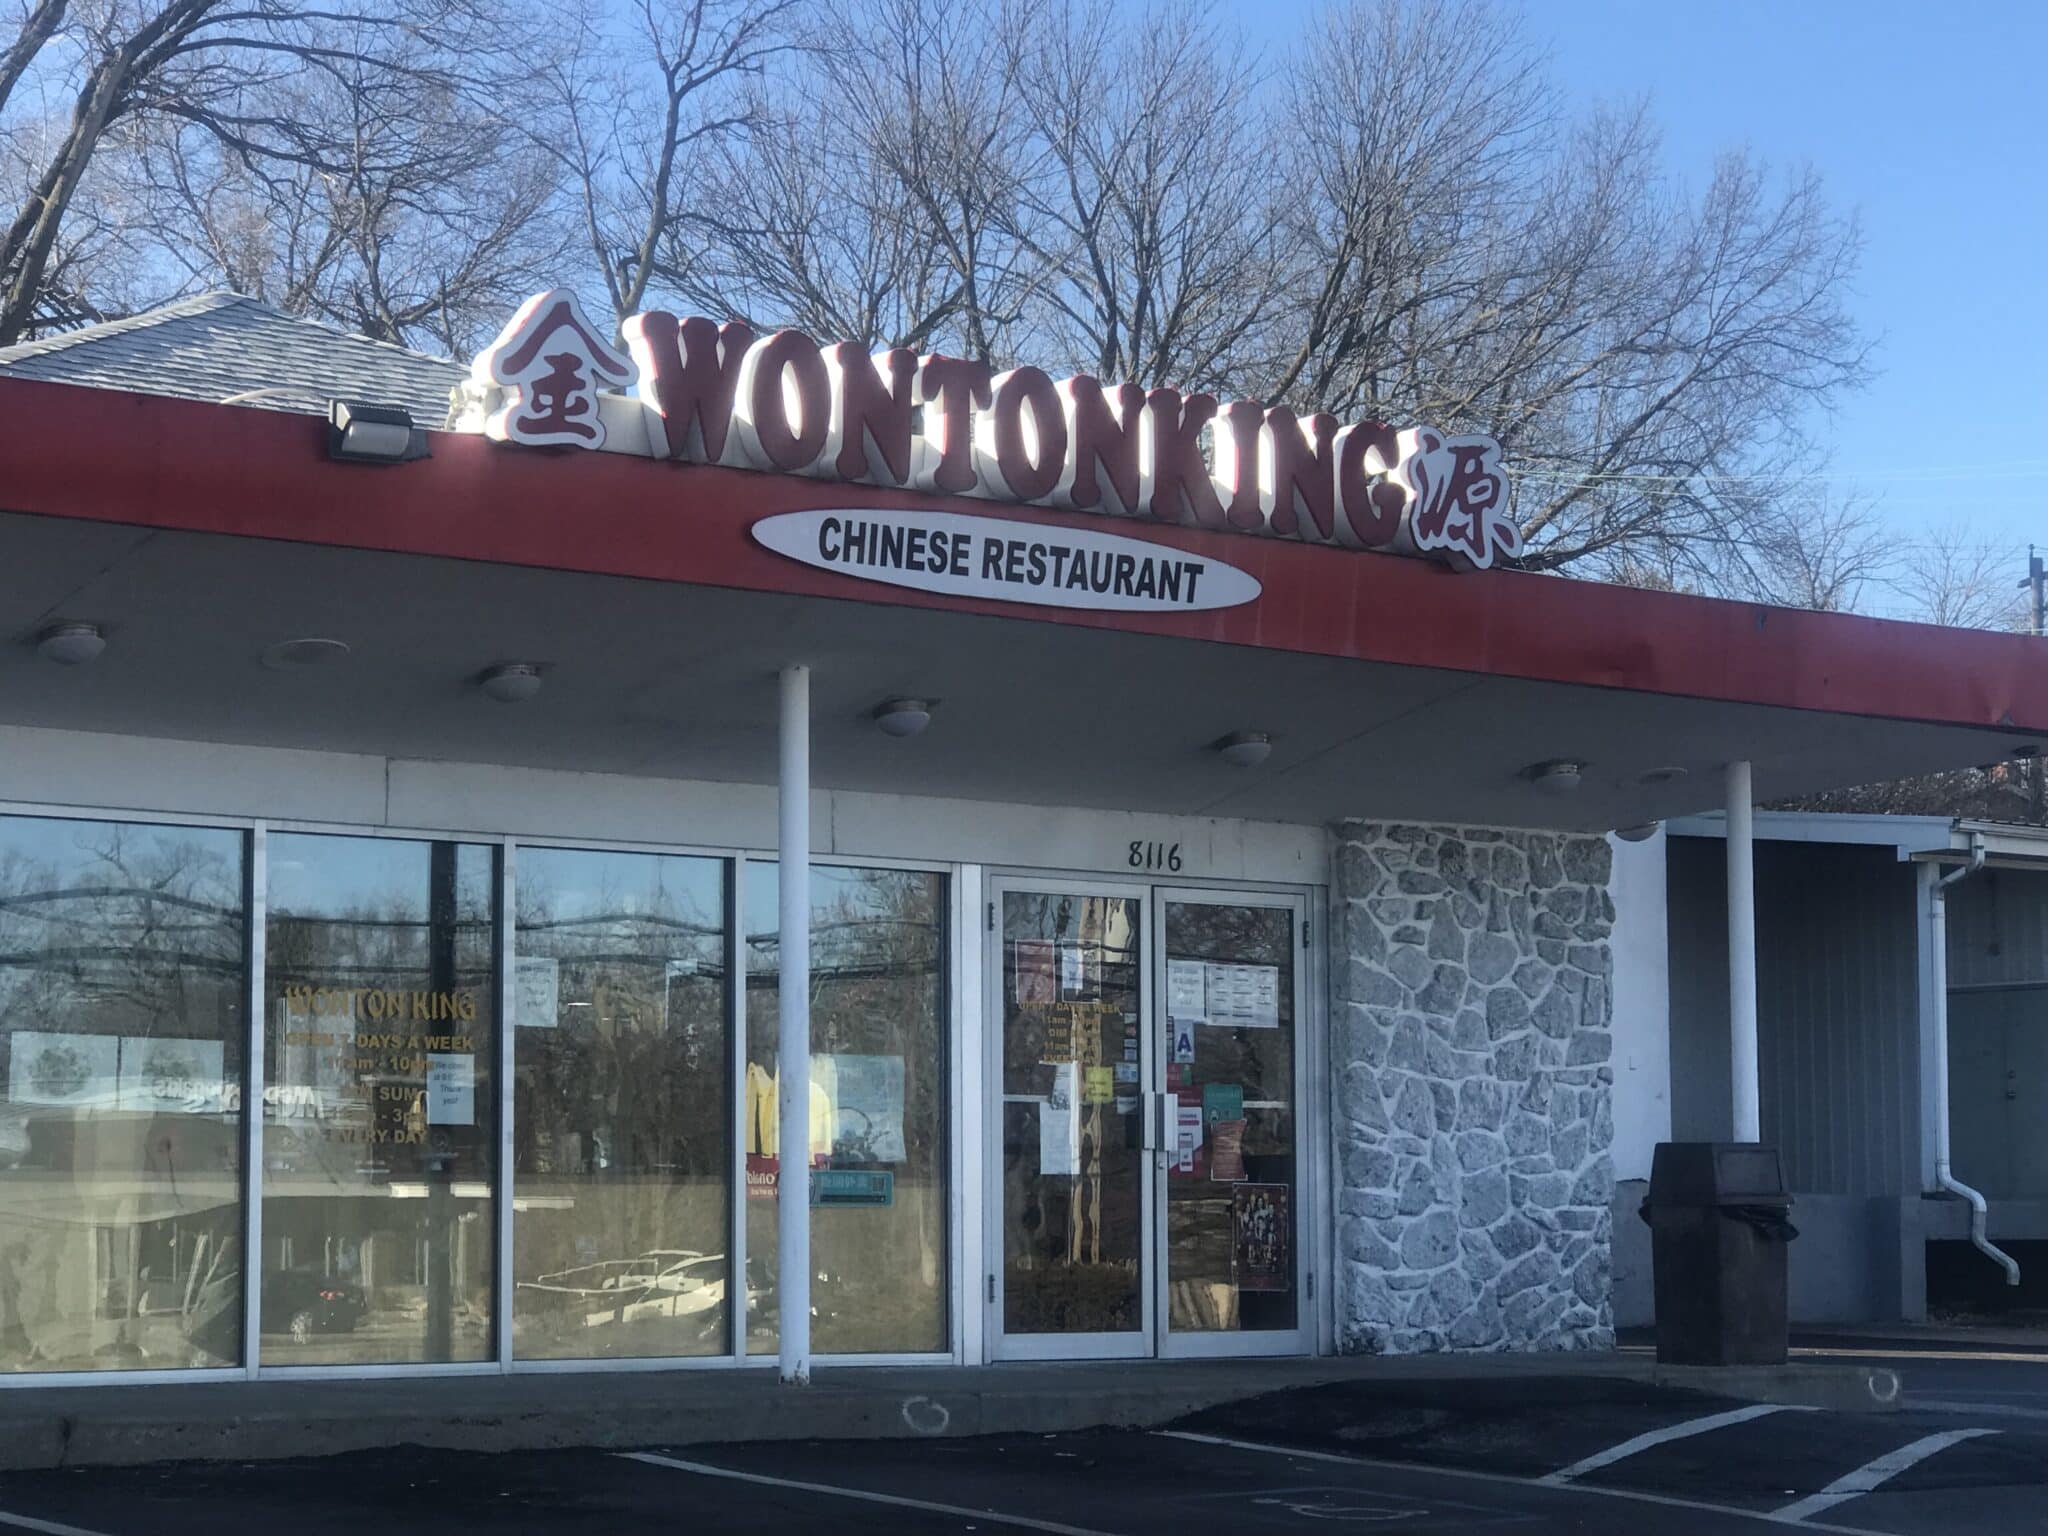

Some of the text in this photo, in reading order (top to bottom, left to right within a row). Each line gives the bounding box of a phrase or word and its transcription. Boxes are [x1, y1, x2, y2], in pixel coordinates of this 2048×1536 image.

[503, 299, 630, 441] 金
[819, 517, 1204, 604] CHINESE RESTAURANT
[1128, 840, 1181, 872] 8116
[412, 990, 476, 1021] KING
[357, 1034, 401, 1049] DAYS
[407, 1035, 419, 1050] A
[424, 1036, 473, 1050] WEEK
[1177, 1032, 1192, 1053] A
[379, 1086, 418, 1101] SUM
[394, 1129, 427, 1145] DAY
